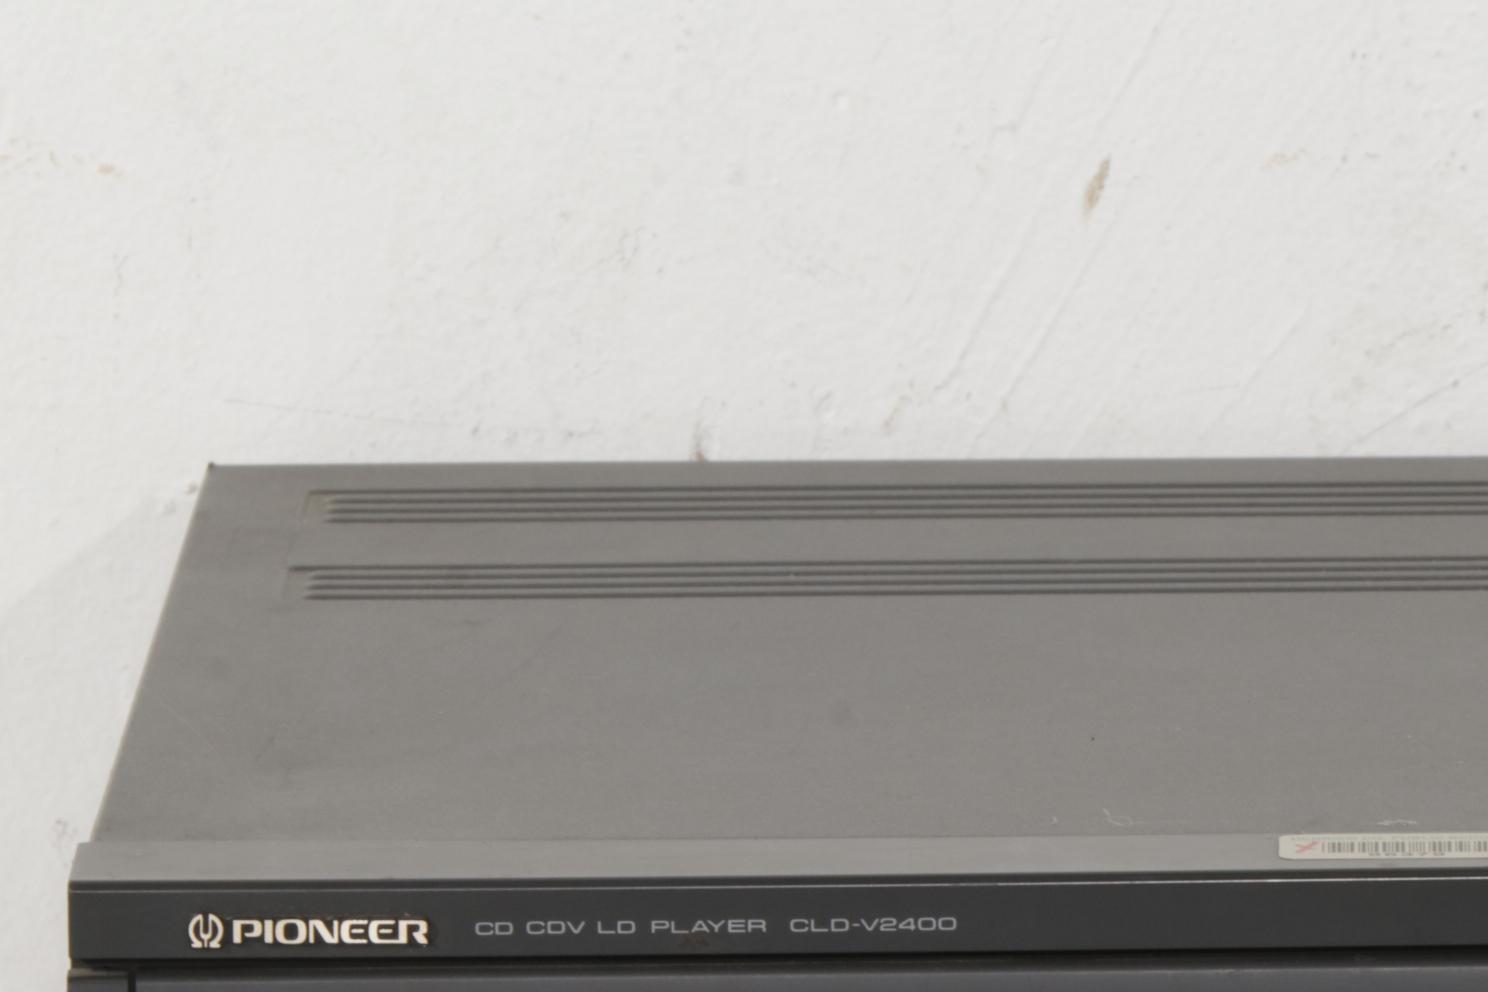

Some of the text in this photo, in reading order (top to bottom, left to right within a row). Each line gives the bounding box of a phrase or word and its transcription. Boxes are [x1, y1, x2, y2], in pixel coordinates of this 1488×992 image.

[232, 918, 429, 944] PIONEER
[474, 916, 958, 936] CD CDV LD PLAYER CLD-V2400
